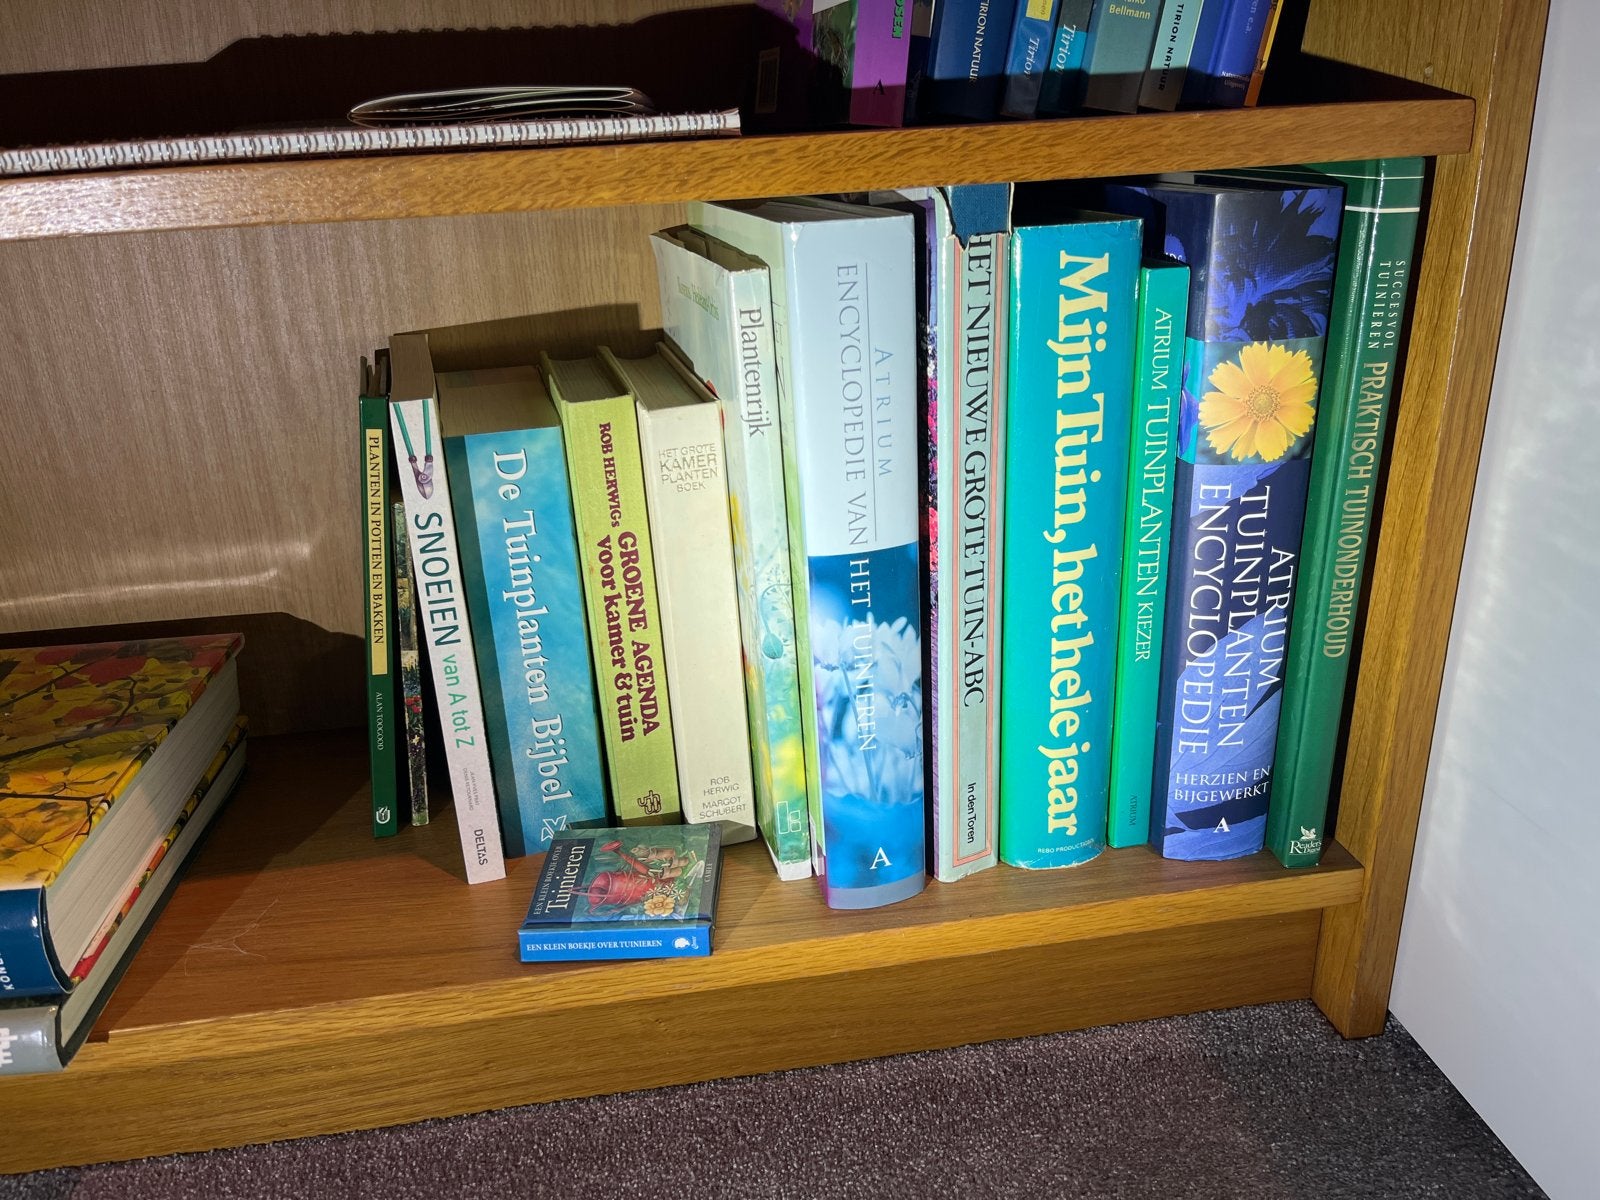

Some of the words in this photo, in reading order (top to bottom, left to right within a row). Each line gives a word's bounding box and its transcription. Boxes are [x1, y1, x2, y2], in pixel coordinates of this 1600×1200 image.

[976, 0, 990, 36] IRION
[1109, 4, 1151, 20] Bellmann
[1169, 4, 1184, 43] TIRION
[1158, 47, 1174, 91] NATUUR
[1046, 250, 1109, 399] Mijn
[1367, 261, 1391, 350] TUINIEREN
[1383, 260, 1406, 349] SUCCESVOL
[739, 307, 772, 438] Plantenrijk
[837, 264, 867, 481] ENCYCLOPEDIE
[1151, 307, 1173, 390] ATRIUM
[965, 303, 991, 446] NIEUWE
[874, 347, 895, 477] ATRIUM
[1345, 361, 1389, 481] PRAKTISCH
[599, 422, 614, 454] ROB
[658, 447, 678, 459] HET
[681, 442, 716, 457] GROTE
[659, 453, 717, 473] KAMER
[368, 436, 382, 498] PLANTEN
[493, 448, 528, 502] De
[661, 466, 718, 485] PLANTEN
[676, 482, 706, 493] BOEK
[1043, 392, 1105, 543] Tuin,
[370, 501, 382, 516] IN
[847, 492, 868, 545] VAN
[963, 450, 988, 558] GROTE
[1136, 397, 1171, 596] TUINPLANTEN
[371, 519, 383, 572] POTTEN
[372, 576, 383, 591] EN
[414, 512, 462, 648] SNOEIEN
[617, 531, 648, 633] GROENE
[849, 558, 871, 607] HET
[1051, 543, 1098, 634] het
[1323, 484, 1370, 658] TUINONDERHOUD
[373, 594, 385, 645] BAKKEN
[502, 508, 549, 705] Tuinplanten
[603, 592, 626, 669] kamer
[1178, 482, 1232, 755] ENCYCLOPEDIE
[1218, 485, 1270, 747] TUINPLANTEN
[1256, 547, 1295, 688] ATRIUM
[963, 561, 985, 708] TUIN-ABC
[1134, 602, 1154, 663] KIEZER
[443, 654, 460, 687] van
[614, 672, 633, 691] &
[631, 640, 660, 736] AGENDA
[851, 619, 876, 751] TUINIEREN
[1049, 630, 1096, 738] hele
[375, 691, 383, 714] ALAN
[447, 693, 468, 706] A
[451, 708, 471, 733] tot
[616, 693, 638, 743] tuin
[376, 715, 384, 750] TOOGOOD
[456, 736, 475, 749] Z
[526, 713, 573, 803] Bijbel
[710, 776, 730, 786] ROB
[1175, 770, 1248, 787] HERZIEN
[1253, 765, 1271, 783] EN
[699, 804, 747, 820] SCHUBERT
[702, 796, 742, 810] MARGOT
[703, 783, 740, 797] HERWIG
[967, 782, 976, 793] In
[967, 795, 976, 813] den
[1038, 741, 1091, 836] jaar
[1174, 781, 1270, 803] BIJGEWERKT
[474, 828, 488, 866] DELTAS
[967, 814, 976, 843] Toren
[1213, 817, 1231, 833] A
[869, 847, 892, 869] A
[1038, 846, 1054, 855] REBO
[544, 845, 586, 913] Tuinieren
[526, 943, 542, 951] EEN
[543, 943, 567, 951] KLEIN
[568, 942, 596, 951] BOEKJE
[597, 941, 619, 949] OVER
[619, 939, 662, 949] TUINIEREN
